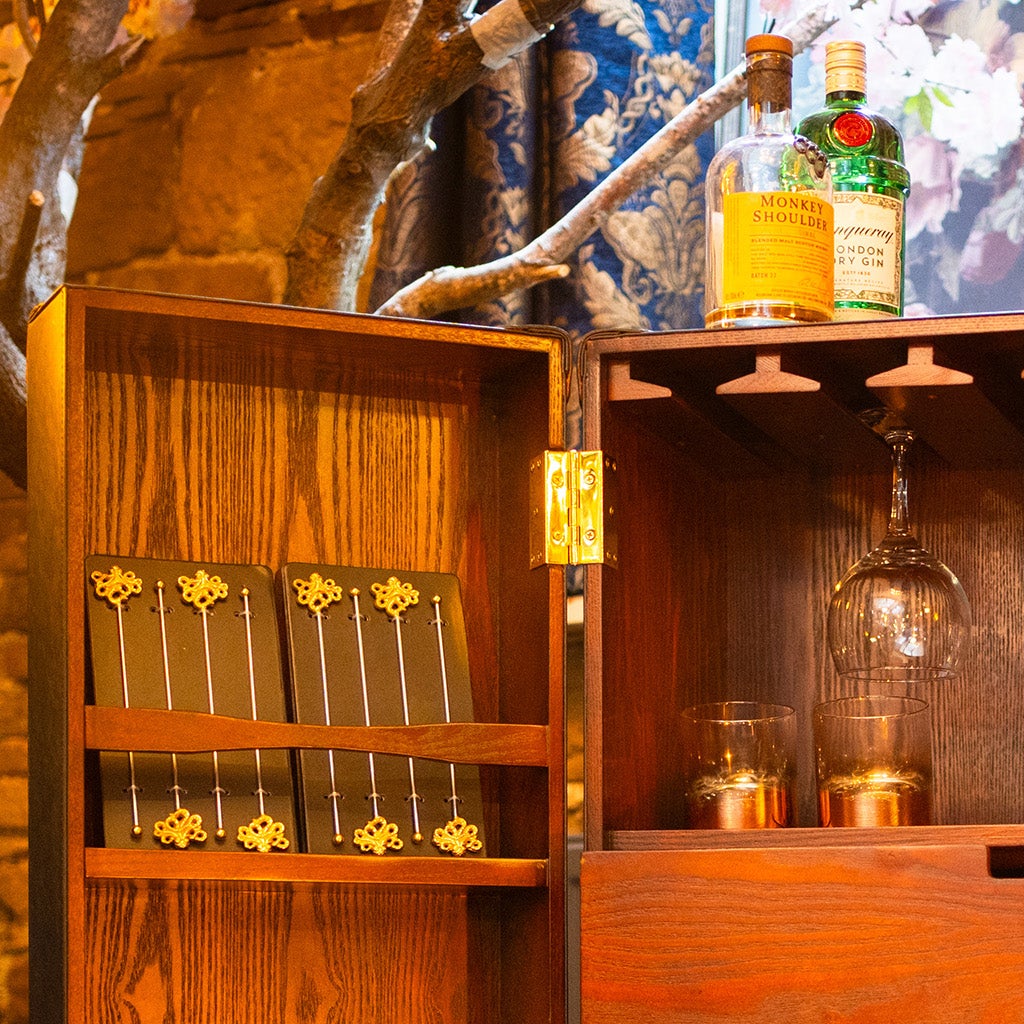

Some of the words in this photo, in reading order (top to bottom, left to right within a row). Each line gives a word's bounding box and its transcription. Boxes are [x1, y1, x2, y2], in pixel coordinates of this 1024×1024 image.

[761, 194, 823, 215] MONKEY
[752, 210, 828, 232] SHOULDER
[834, 226, 894, 245] nqueray
[836, 245, 884, 257] ONDON
[834, 256, 856, 265] RY
[861, 257, 884, 268] GIN
